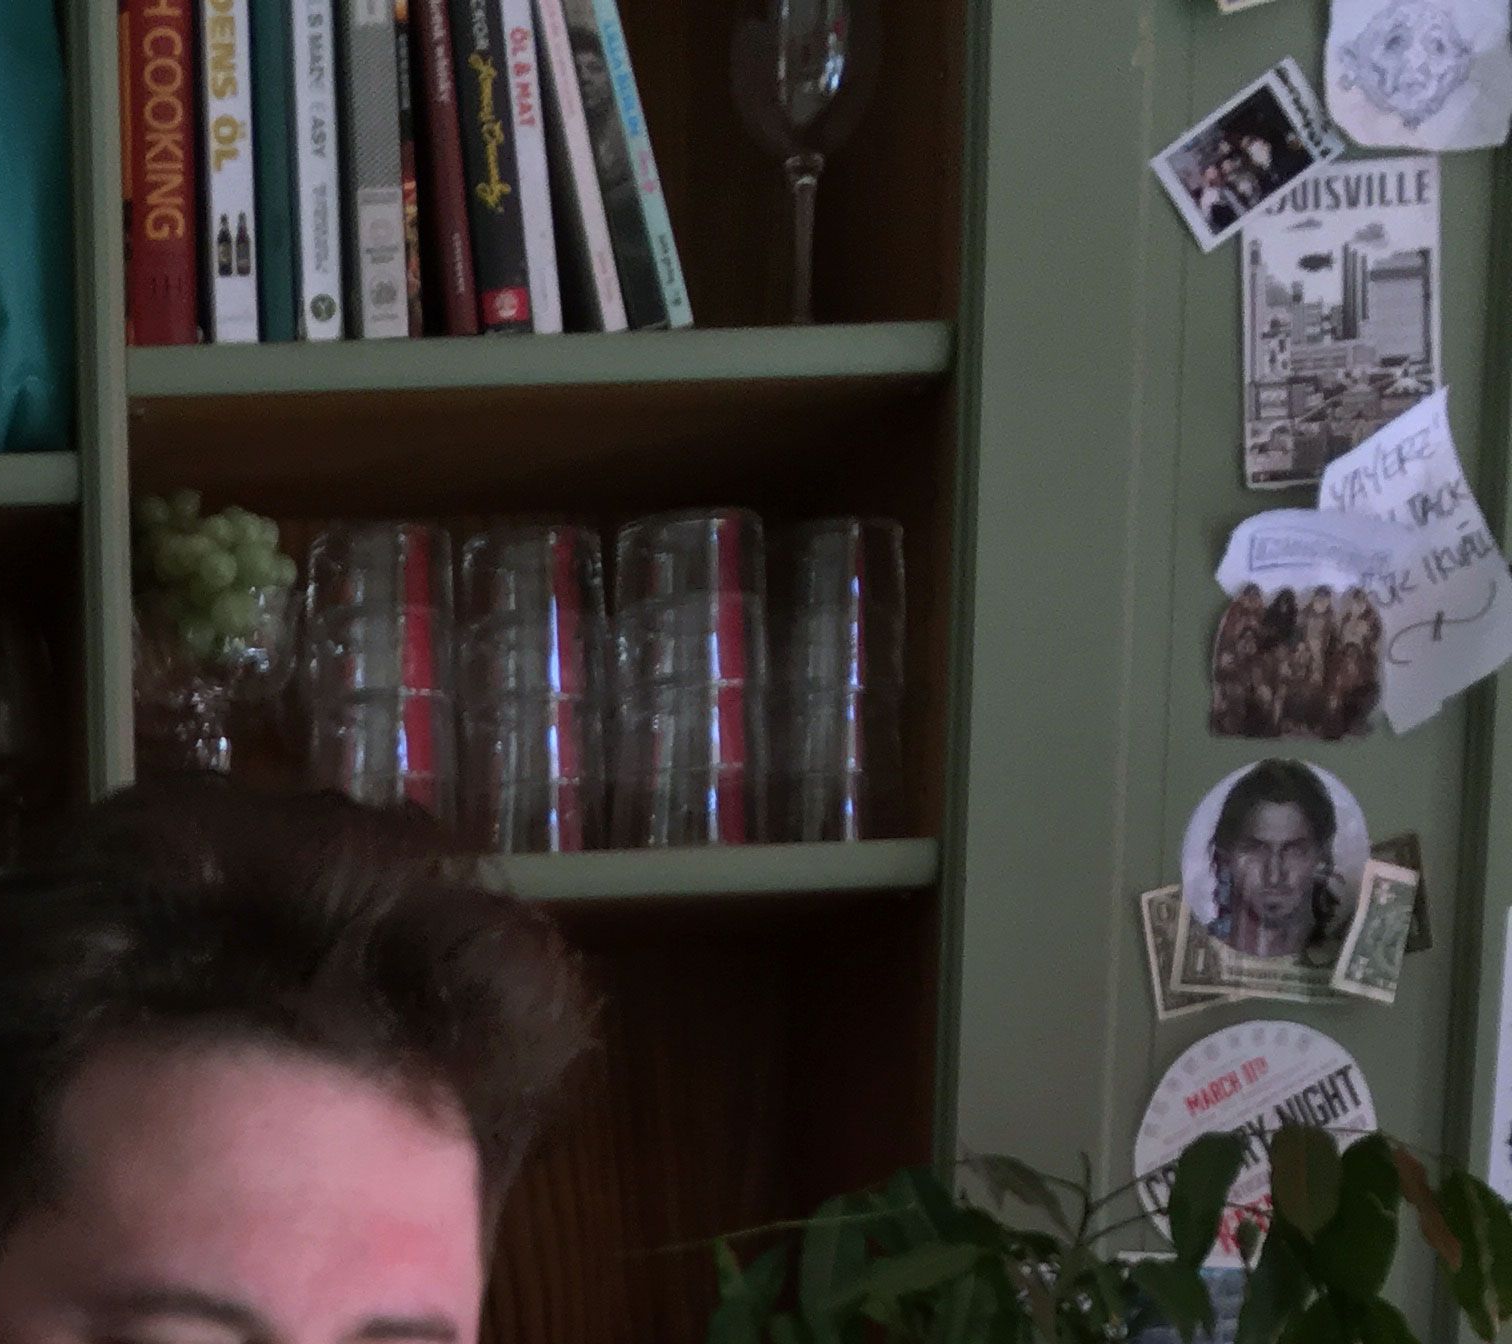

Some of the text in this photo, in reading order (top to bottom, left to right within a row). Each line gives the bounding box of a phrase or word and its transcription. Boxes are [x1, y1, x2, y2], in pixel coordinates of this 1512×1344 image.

[143, 25, 185, 242] COOKING
[1265, 168, 1432, 216] UISVILLE
[1183, 1071, 1242, 1118] MARCH
